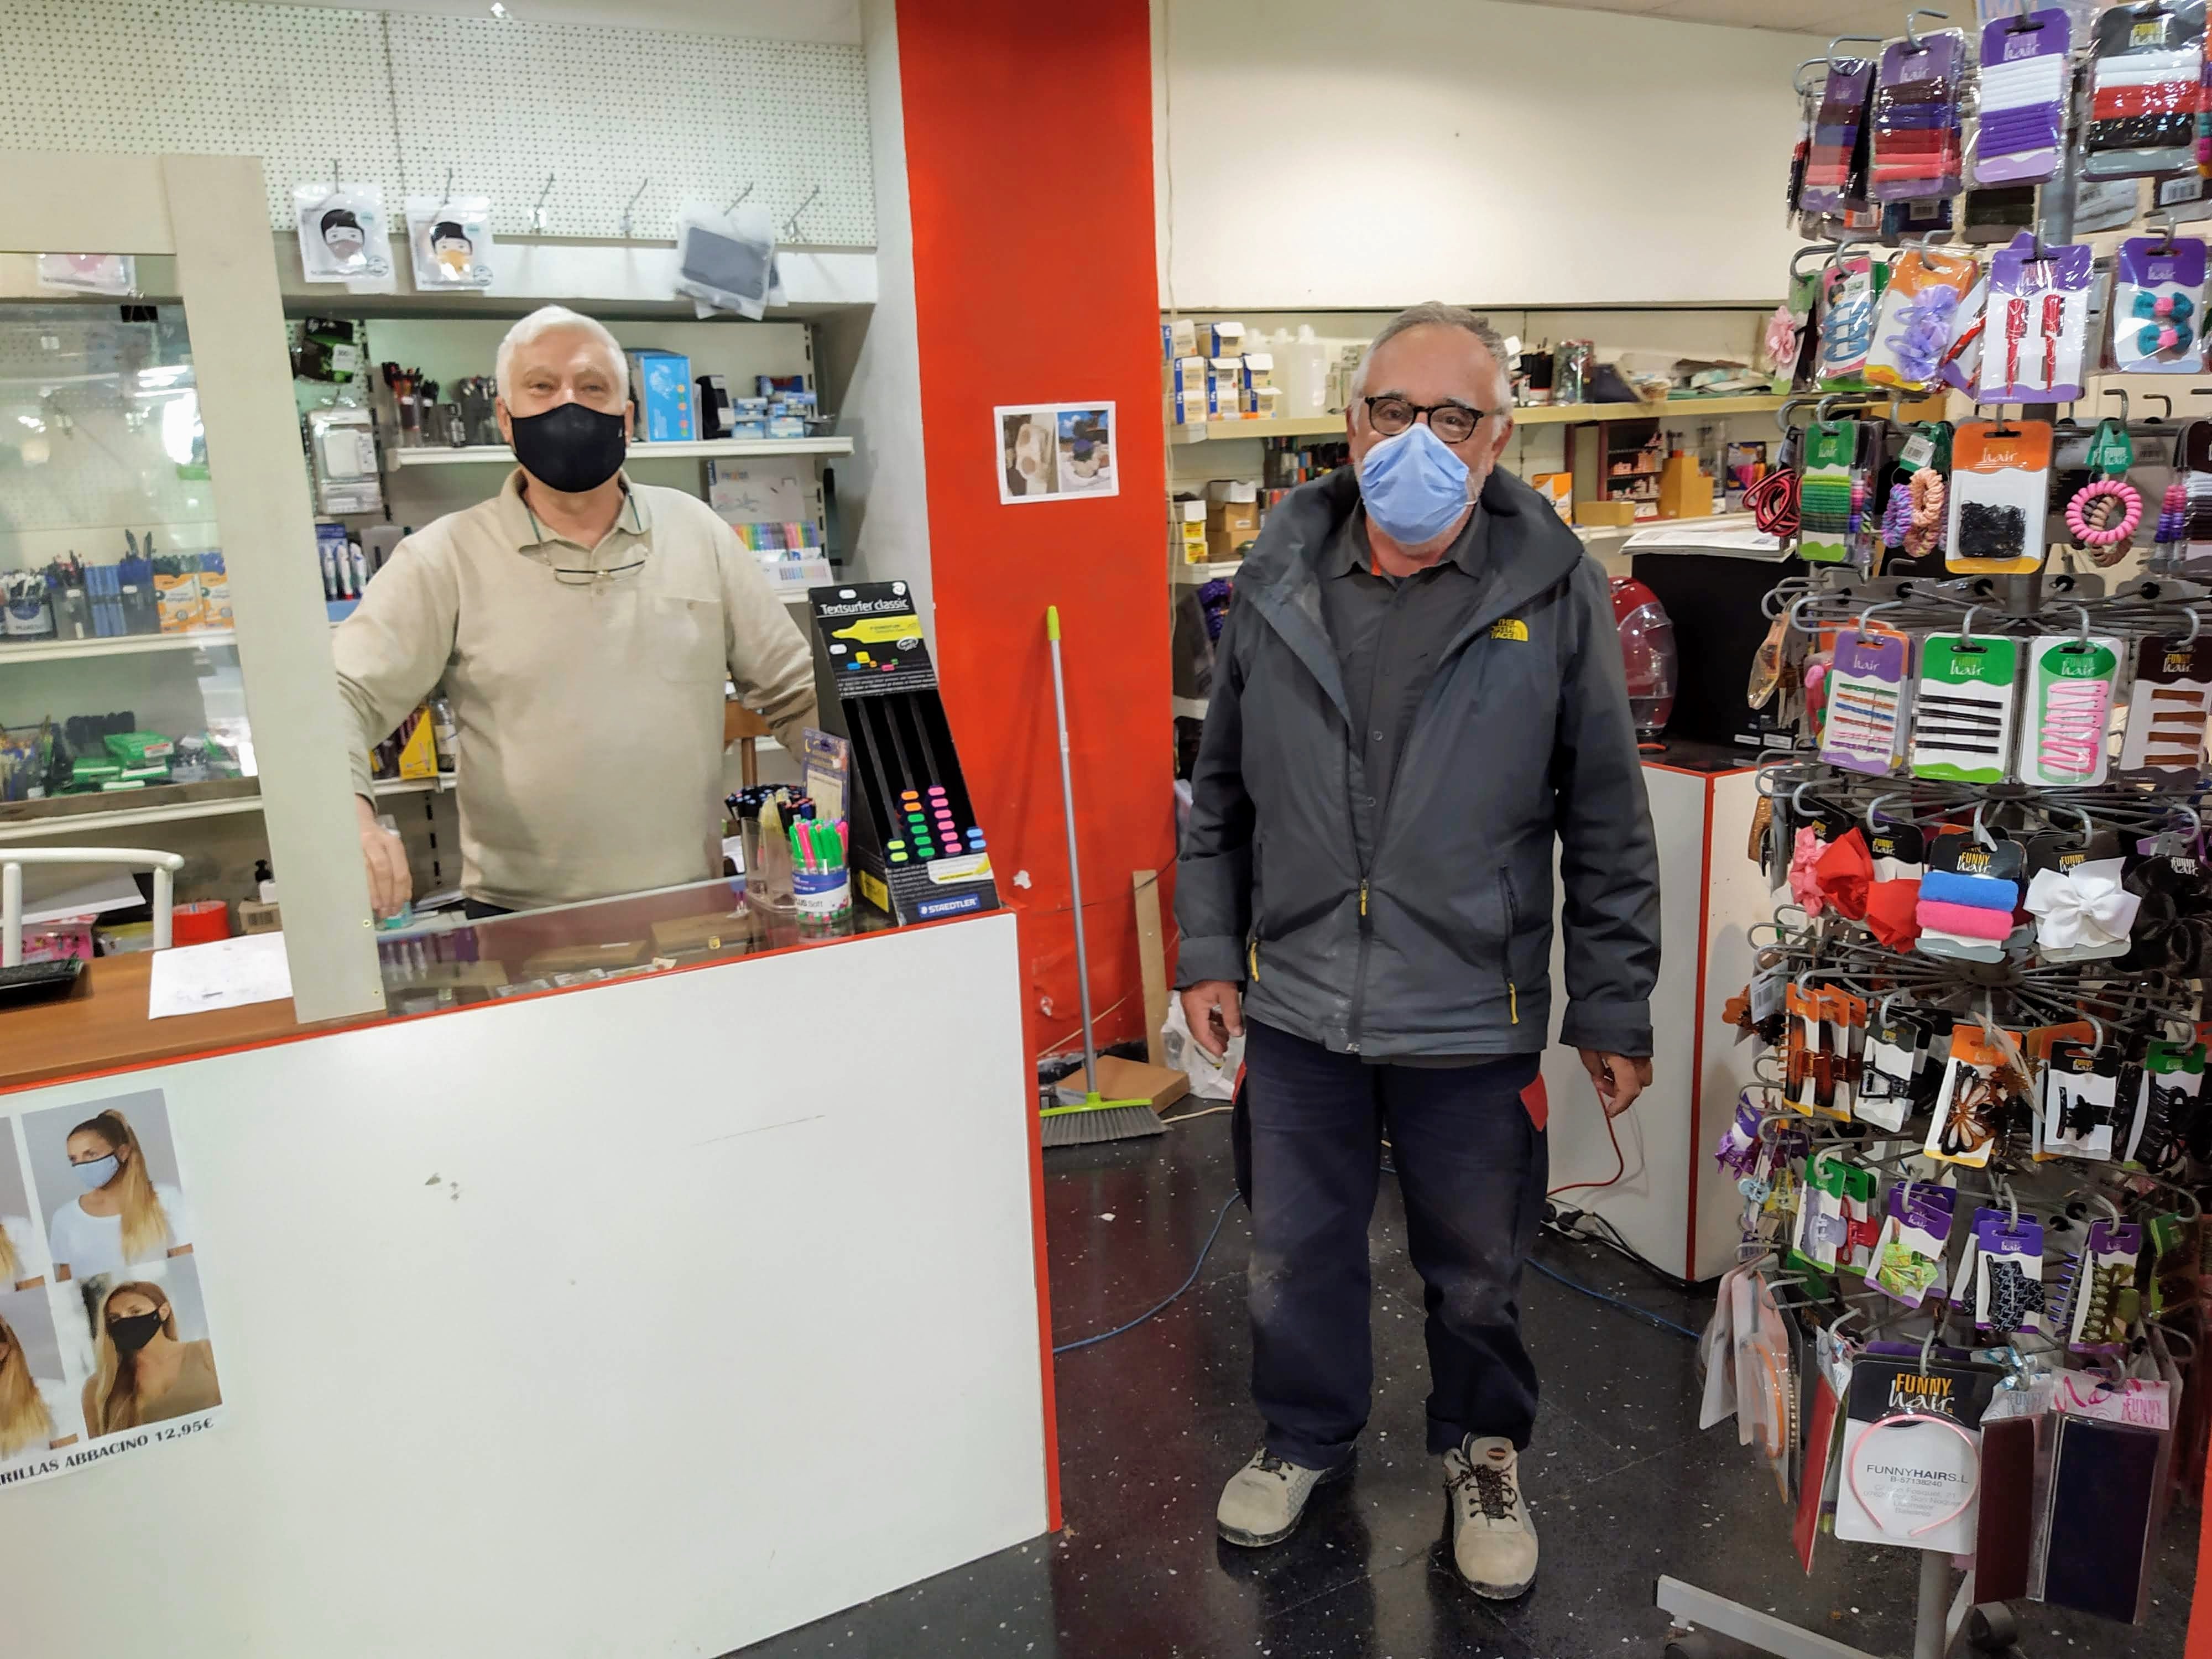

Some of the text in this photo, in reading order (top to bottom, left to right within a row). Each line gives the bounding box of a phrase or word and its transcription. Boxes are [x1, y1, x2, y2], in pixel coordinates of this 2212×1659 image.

[1983, 446, 2018, 463] hair
[819, 598, 910, 615] Textsurfer classic
[1490, 625, 1514, 633] ORTH
[1490, 632, 1514, 640] FACE
[1854, 654, 1880, 671] hair
[1949, 659, 1985, 675] hair
[2062, 660, 2096, 676] hair
[2163, 658, 2195, 673] hair
[1872, 840, 1896, 856] hair
[1874, 837, 1894, 848] FUNNY
[1957, 855, 1992, 873] hair
[1961, 851, 1991, 866] FUNNY
[2060, 854, 2085, 865] FUNNY
[2172, 857, 2195, 869] FUNNY
[928, 899, 977, 914] STAEDTLER
[1895, 1373, 1953, 1397] FUNNY
[1888, 1379, 1955, 1411] hair
[0, 1458, 60, 1486] RILLAS
[65, 1435, 149, 1468] ABBACINO
[1890, 1475, 1943, 1488] B-57138240
